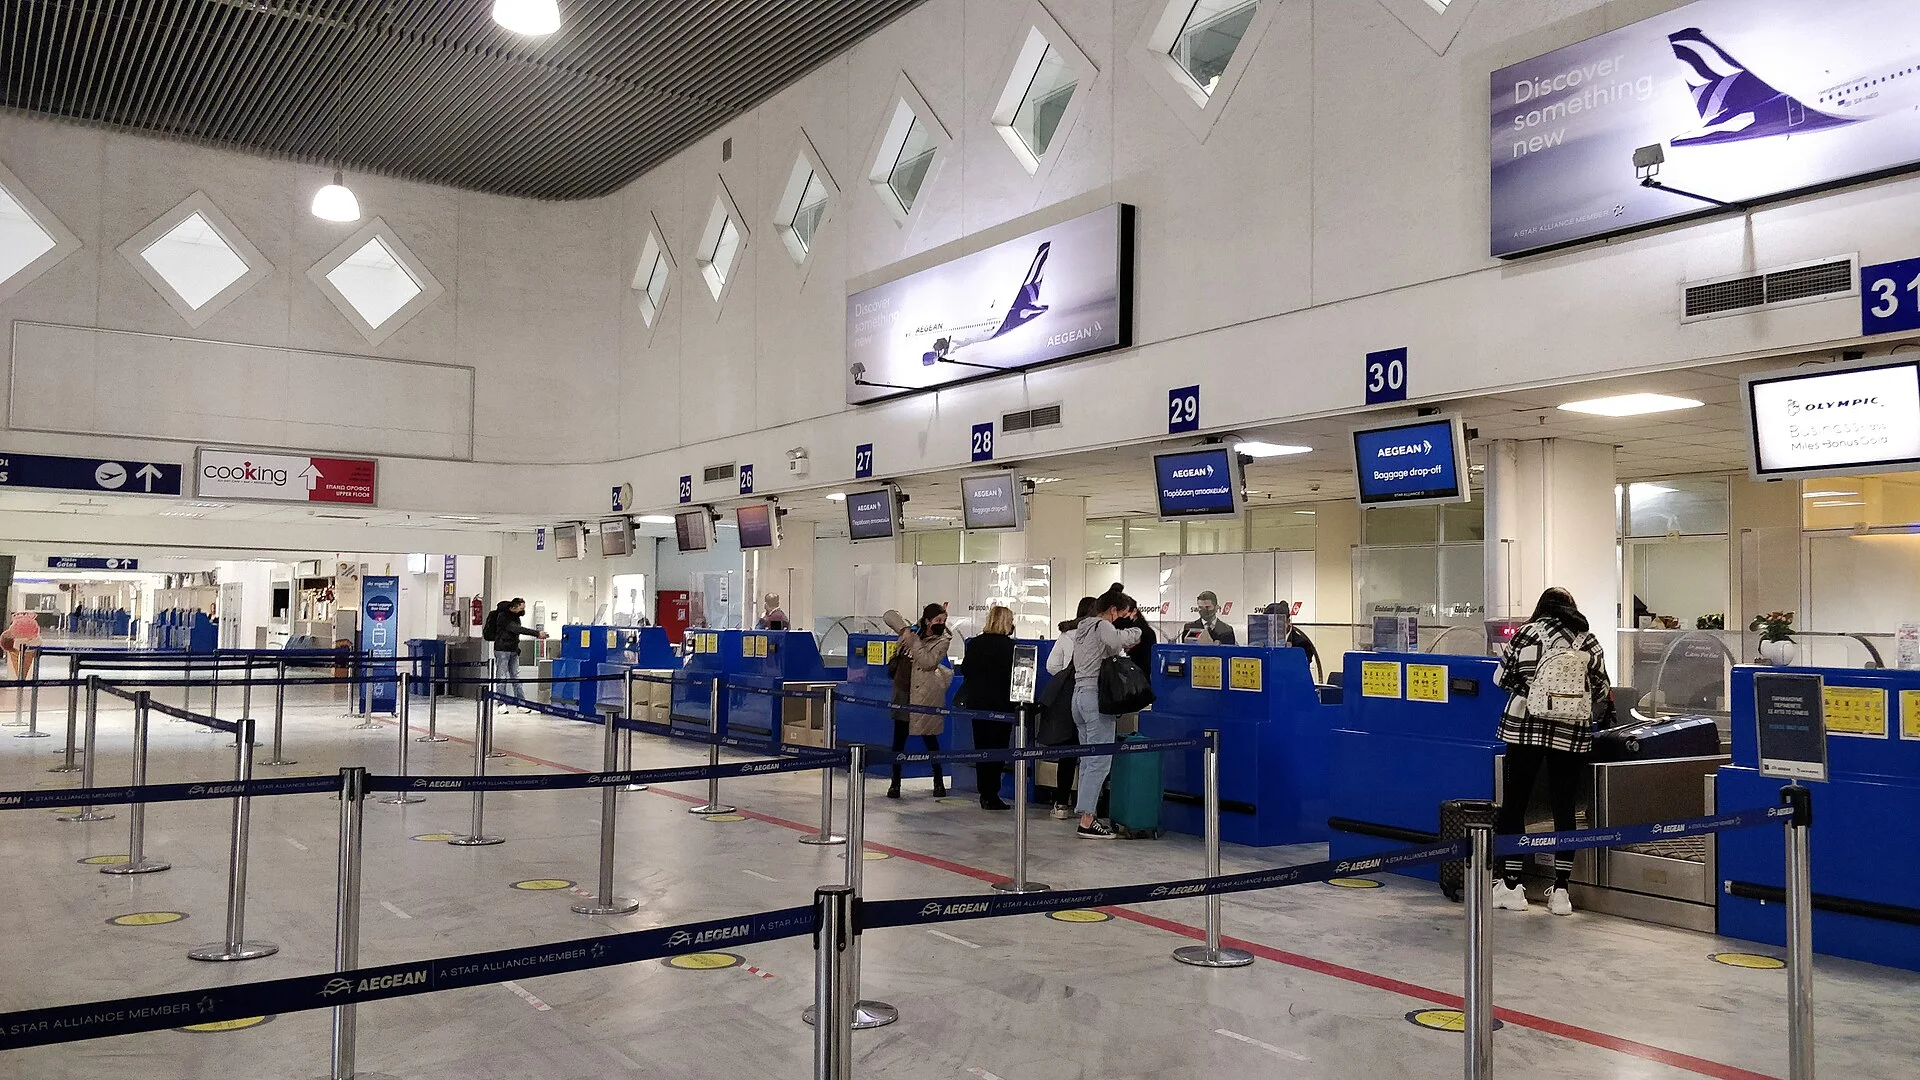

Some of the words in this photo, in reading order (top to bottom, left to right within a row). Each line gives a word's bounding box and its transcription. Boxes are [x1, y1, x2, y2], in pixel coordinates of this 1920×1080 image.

[1514, 54, 1624, 104] Discover
[1514, 74, 1652, 131] something
[1512, 128, 1566, 158] new
[1520, 227, 1538, 236] STAR
[1540, 220, 1574, 232] ALLIANCE
[1046, 326, 1092, 348] AEGEAN
[1369, 360, 1404, 393] 30
[1170, 396, 1197, 424] 29
[1805, 396, 1878, 411] OLYMPIC
[973, 431, 991, 453] 28
[1378, 444, 1422, 458] AEGEAN
[856, 451, 871, 471] 27
[204, 461, 288, 486] cooking
[741, 471, 752, 488] 26
[1172, 468, 1206, 478] AEGEAN
[1374, 470, 1408, 482] Baggage
[1410, 464, 1442, 478] drop-off
[680, 481, 690, 497] 25
[754, 763, 780, 771] AEGEAN
[602, 775, 631, 783] AEGEAN
[207, 785, 245, 794] AEGEAN
[0, 796, 21, 804] EAN
[1663, 824, 1685, 833] AEGEAN
[1530, 837, 1556, 846] AEGEAN
[1350, 858, 1381, 871] AEGEAN
[1403, 851, 1428, 860] ALLIANCE
[1168, 884, 1206, 895] AEGEAN
[1233, 878, 1261, 886] ALLIANCE
[1262, 874, 1288, 882] MEMBER
[943, 902, 990, 915] AEGEAN
[1024, 898, 1058, 907] ALLIANCE
[1060, 895, 1092, 904] MEMBER
[695, 924, 750, 944] AEGEAN
[768, 919, 791, 930] STAR
[794, 915, 816, 924] ALLI
[357, 970, 427, 993] AEGEAN
[440, 970, 448, 978] A
[450, 964, 479, 977] STAR
[482, 956, 536, 971] ALLIANCE
[540, 948, 586, 963] MEMBER
[0, 1027, 6, 1036] A
[10, 1020, 48, 1034] STAR
[53, 1012, 124, 1029] ALLIANCE
[129, 1003, 190, 1019] MEMBER
